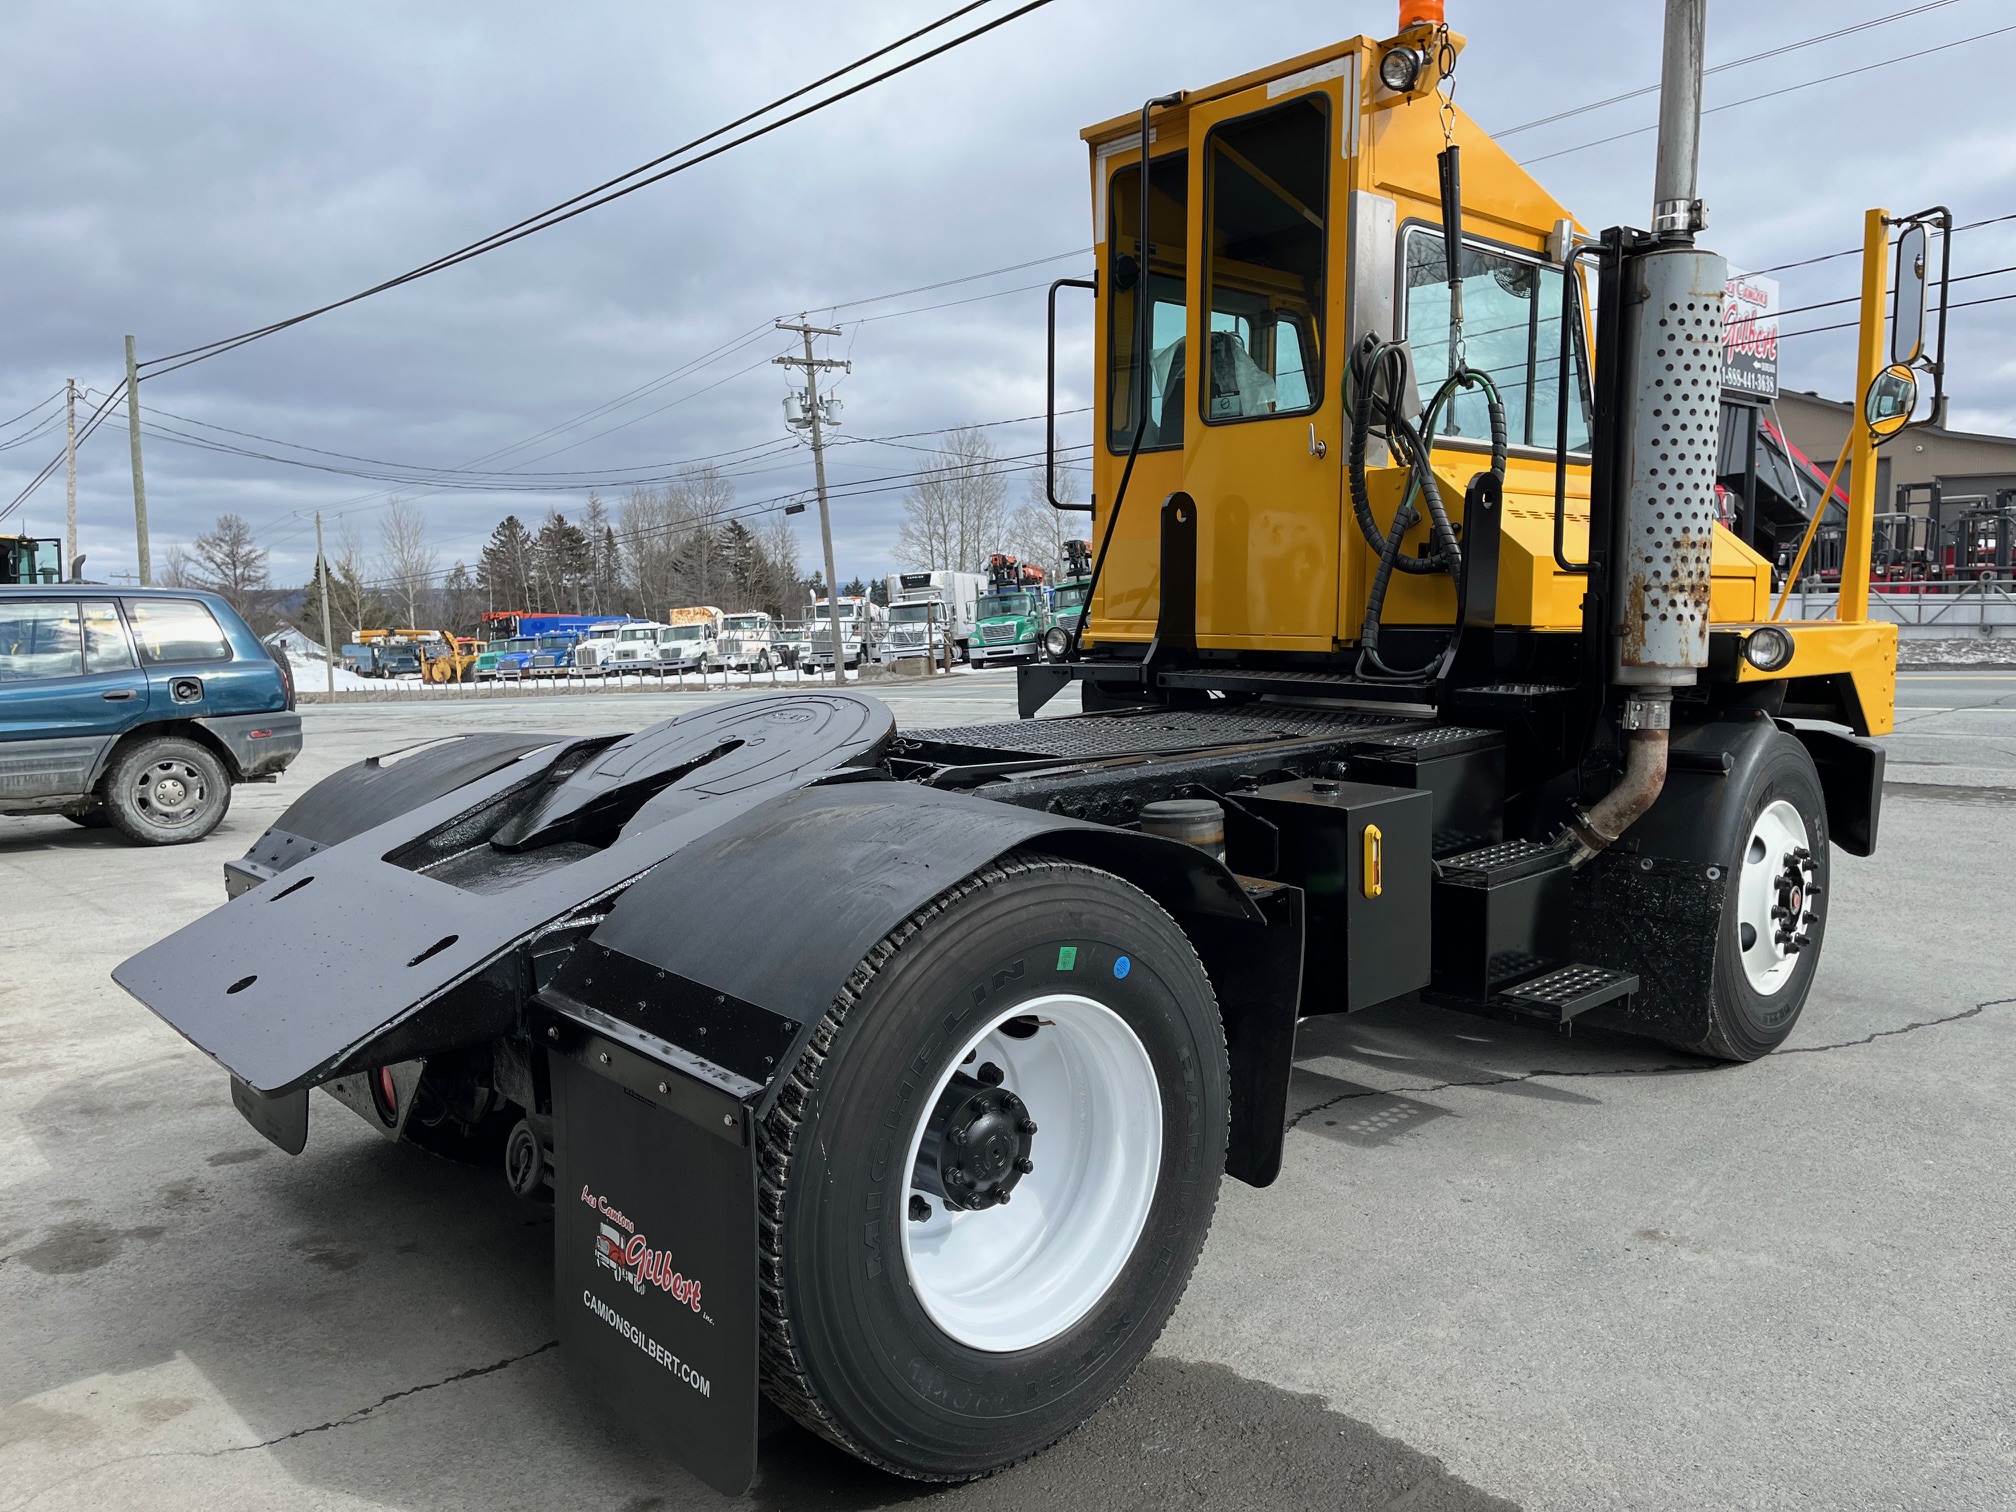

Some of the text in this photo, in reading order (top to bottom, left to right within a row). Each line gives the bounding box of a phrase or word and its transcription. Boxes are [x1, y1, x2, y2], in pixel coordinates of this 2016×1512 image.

[1722, 301, 1777, 364] Gilbert
[864, 957, 1030, 1281] MICHELIN
[581, 1185, 635, 1234] Les Camions
[625, 1234, 701, 1312] Gilbert
[583, 1290, 711, 1398] CAMIONSGILBERT.COM
